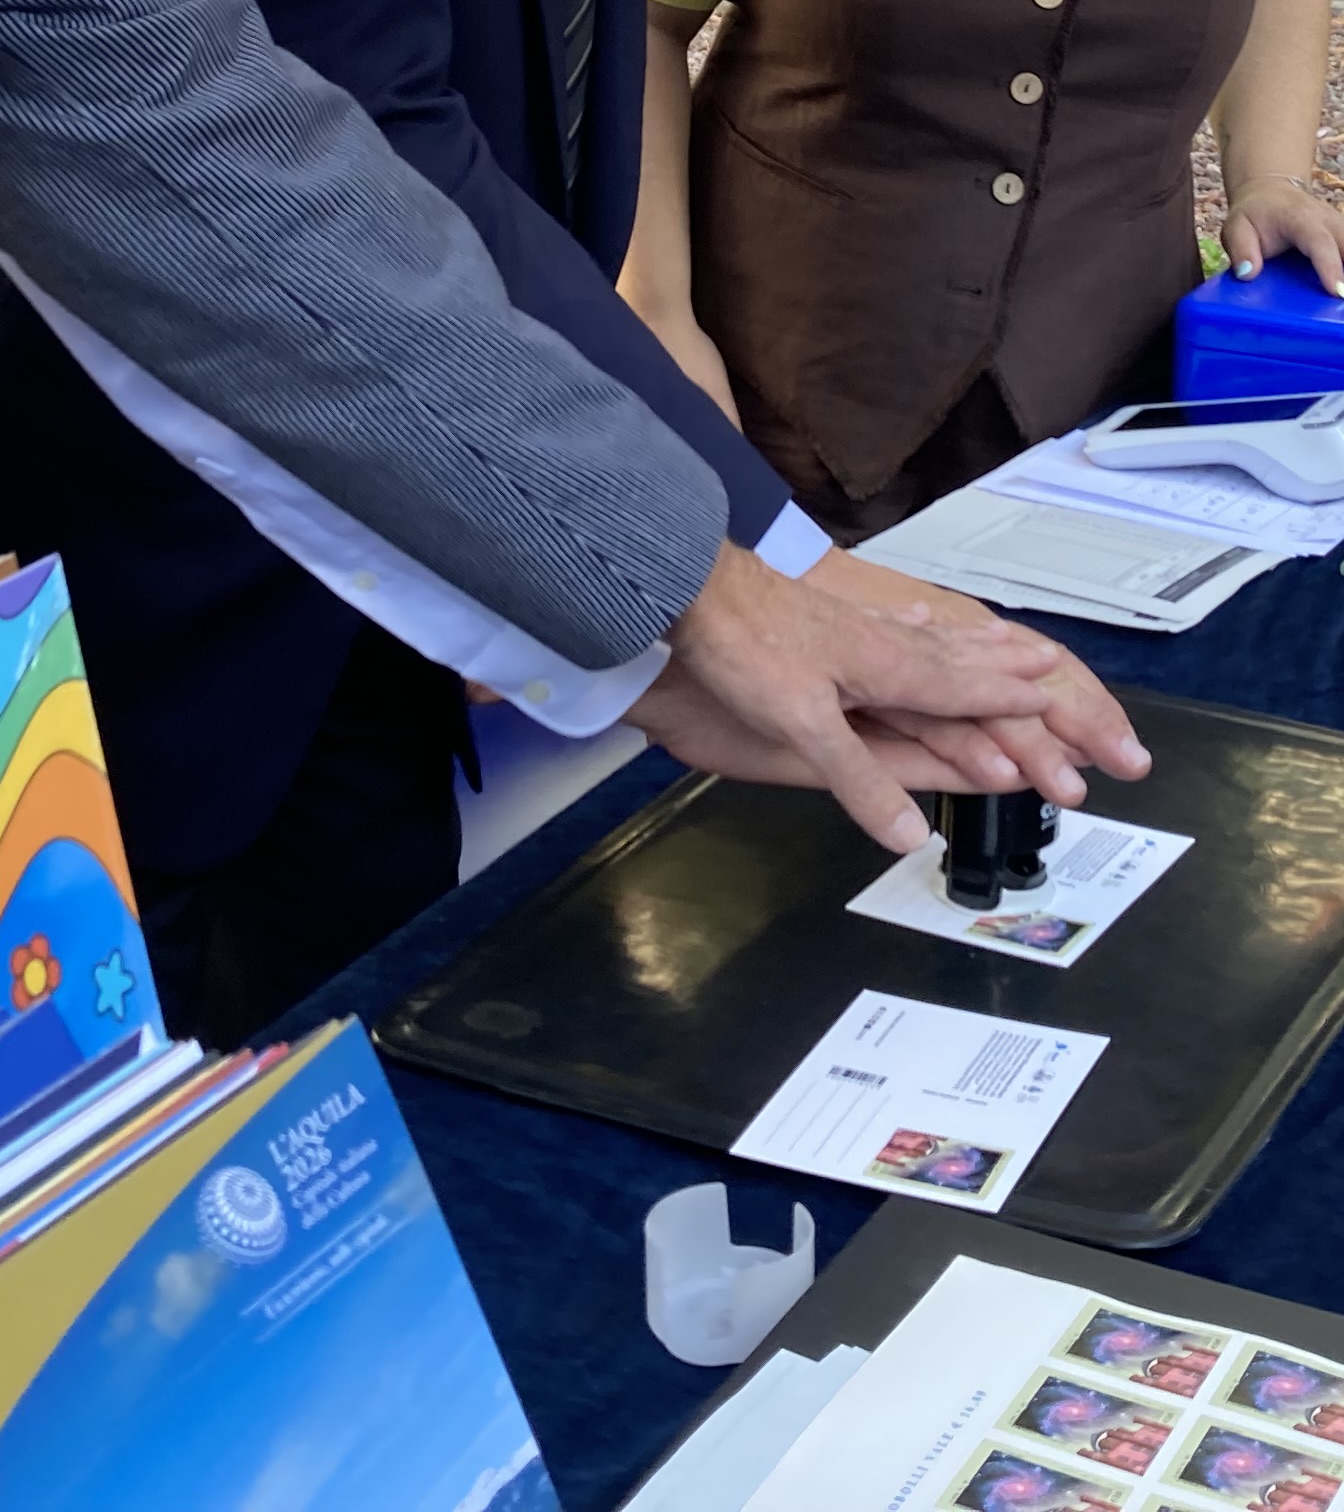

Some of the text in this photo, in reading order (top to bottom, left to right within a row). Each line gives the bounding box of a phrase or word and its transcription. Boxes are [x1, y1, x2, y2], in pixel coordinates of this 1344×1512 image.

[268, 1082, 366, 1167] L'AQUILA
[280, 1145, 333, 1192] 2026
[887, 1465, 929, 1512] OBOLLI
